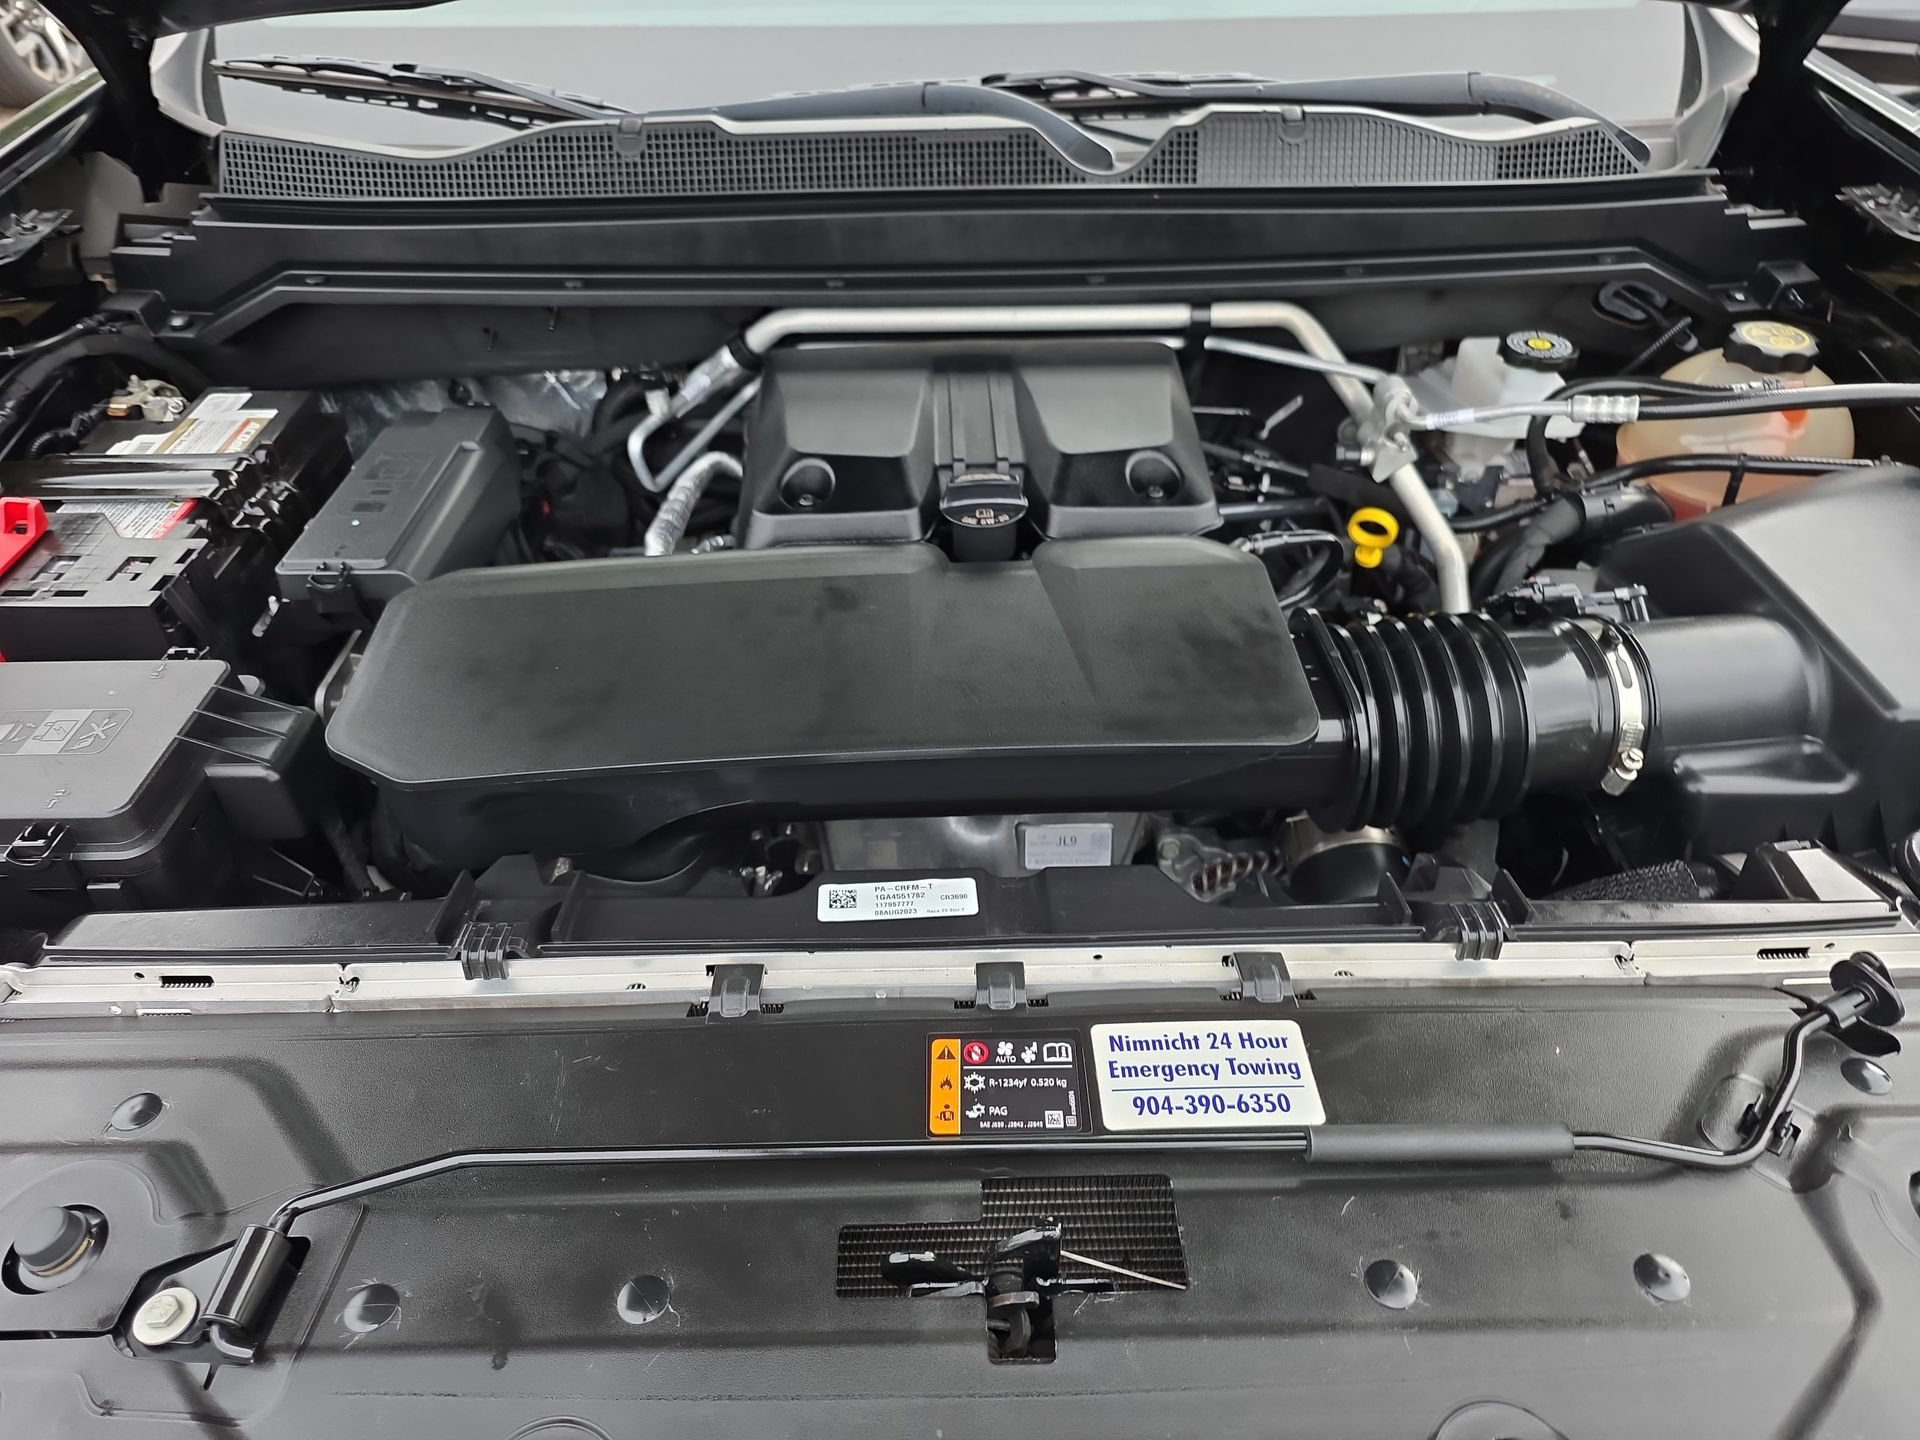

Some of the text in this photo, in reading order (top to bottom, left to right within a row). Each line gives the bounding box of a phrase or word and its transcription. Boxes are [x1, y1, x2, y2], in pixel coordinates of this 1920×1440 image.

[1056, 834, 1077, 847] JL9
[875, 883, 933, 892] PA-CRFM-T
[1108, 1032, 1288, 1052] Nimnicht 24 Hour
[995, 1055, 1017, 1063] AUTO
[1108, 1057, 1302, 1082] Emergency Towing
[989, 1077, 1067, 1089] R-1234yf 0.520 kg
[1132, 1092, 1291, 1116] 904-390-6350
[988, 1106, 1008, 1116] PAG
